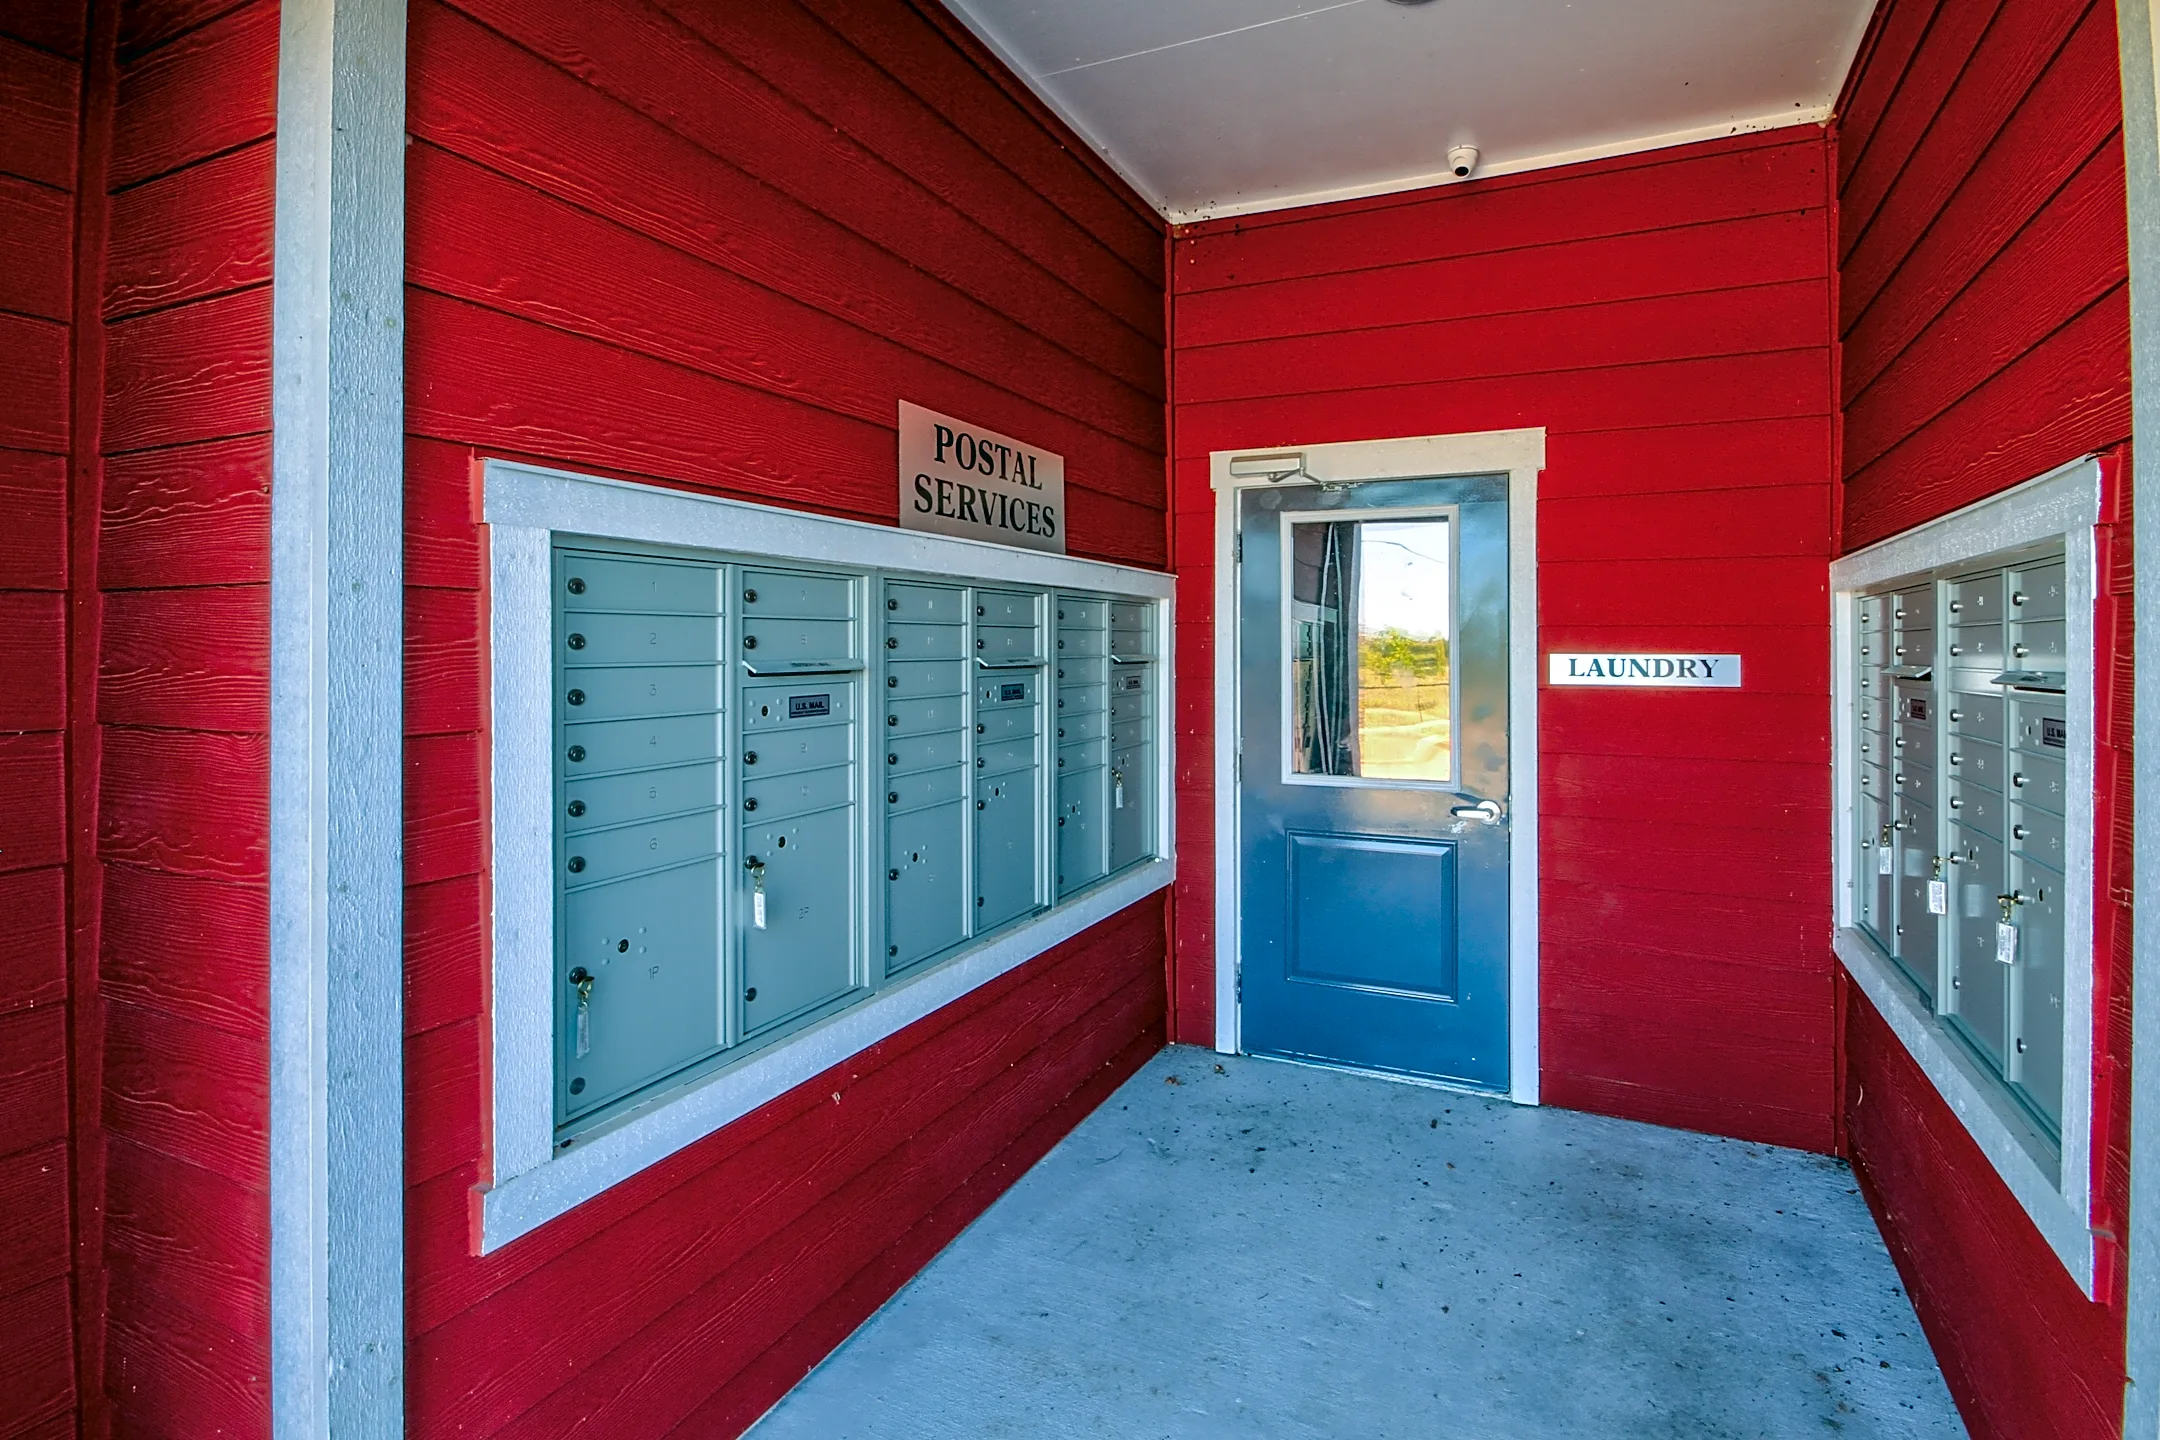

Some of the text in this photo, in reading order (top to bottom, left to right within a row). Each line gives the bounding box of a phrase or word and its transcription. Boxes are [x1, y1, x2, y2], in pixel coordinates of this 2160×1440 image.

[934, 423, 1043, 491] POSTAL
[914, 473, 1056, 538] SERVICES
[649, 632, 657, 645] 2
[1568, 657, 1719, 679] LAUNDRY
[649, 683, 657, 697] 3
[795, 701, 825, 711] U.S. MAIL
[2056, 728, 2066, 740] MAI
[649, 735, 657, 748] 4
[649, 786, 657, 799] 5
[649, 838, 658, 850] 6
[648, 965, 660, 980] 1P
